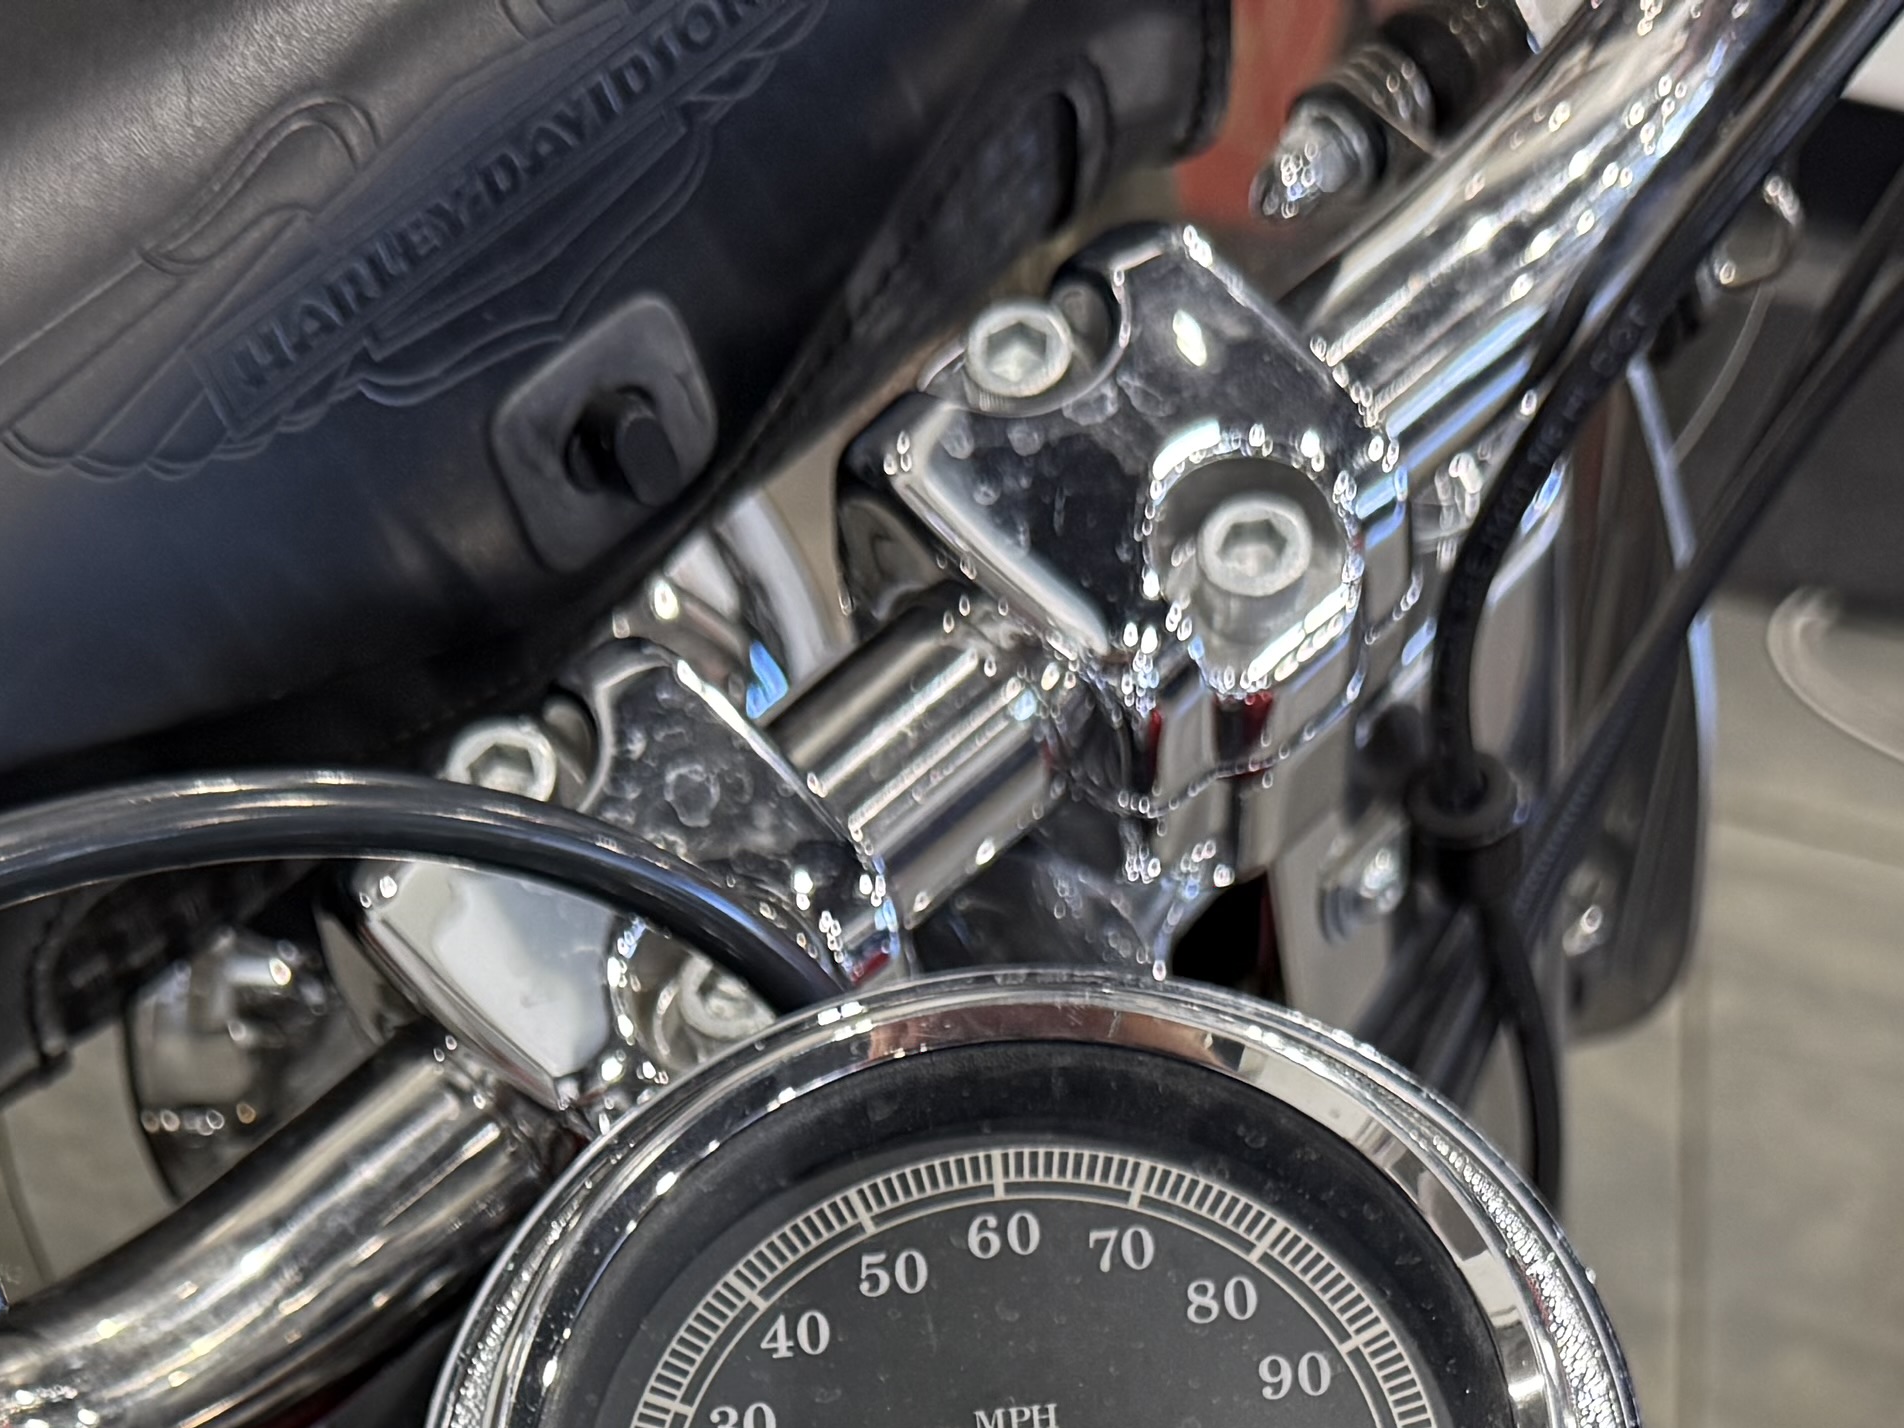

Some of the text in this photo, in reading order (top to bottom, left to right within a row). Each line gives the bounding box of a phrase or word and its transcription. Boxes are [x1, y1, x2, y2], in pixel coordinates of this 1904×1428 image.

[967, 1210, 1040, 1258] 60
[1088, 1227, 1155, 1273] 70
[859, 1250, 928, 1298] 50
[1186, 1276, 1258, 1324] 80
[760, 1310, 830, 1359] 40
[1258, 1352, 1332, 1400] 90
